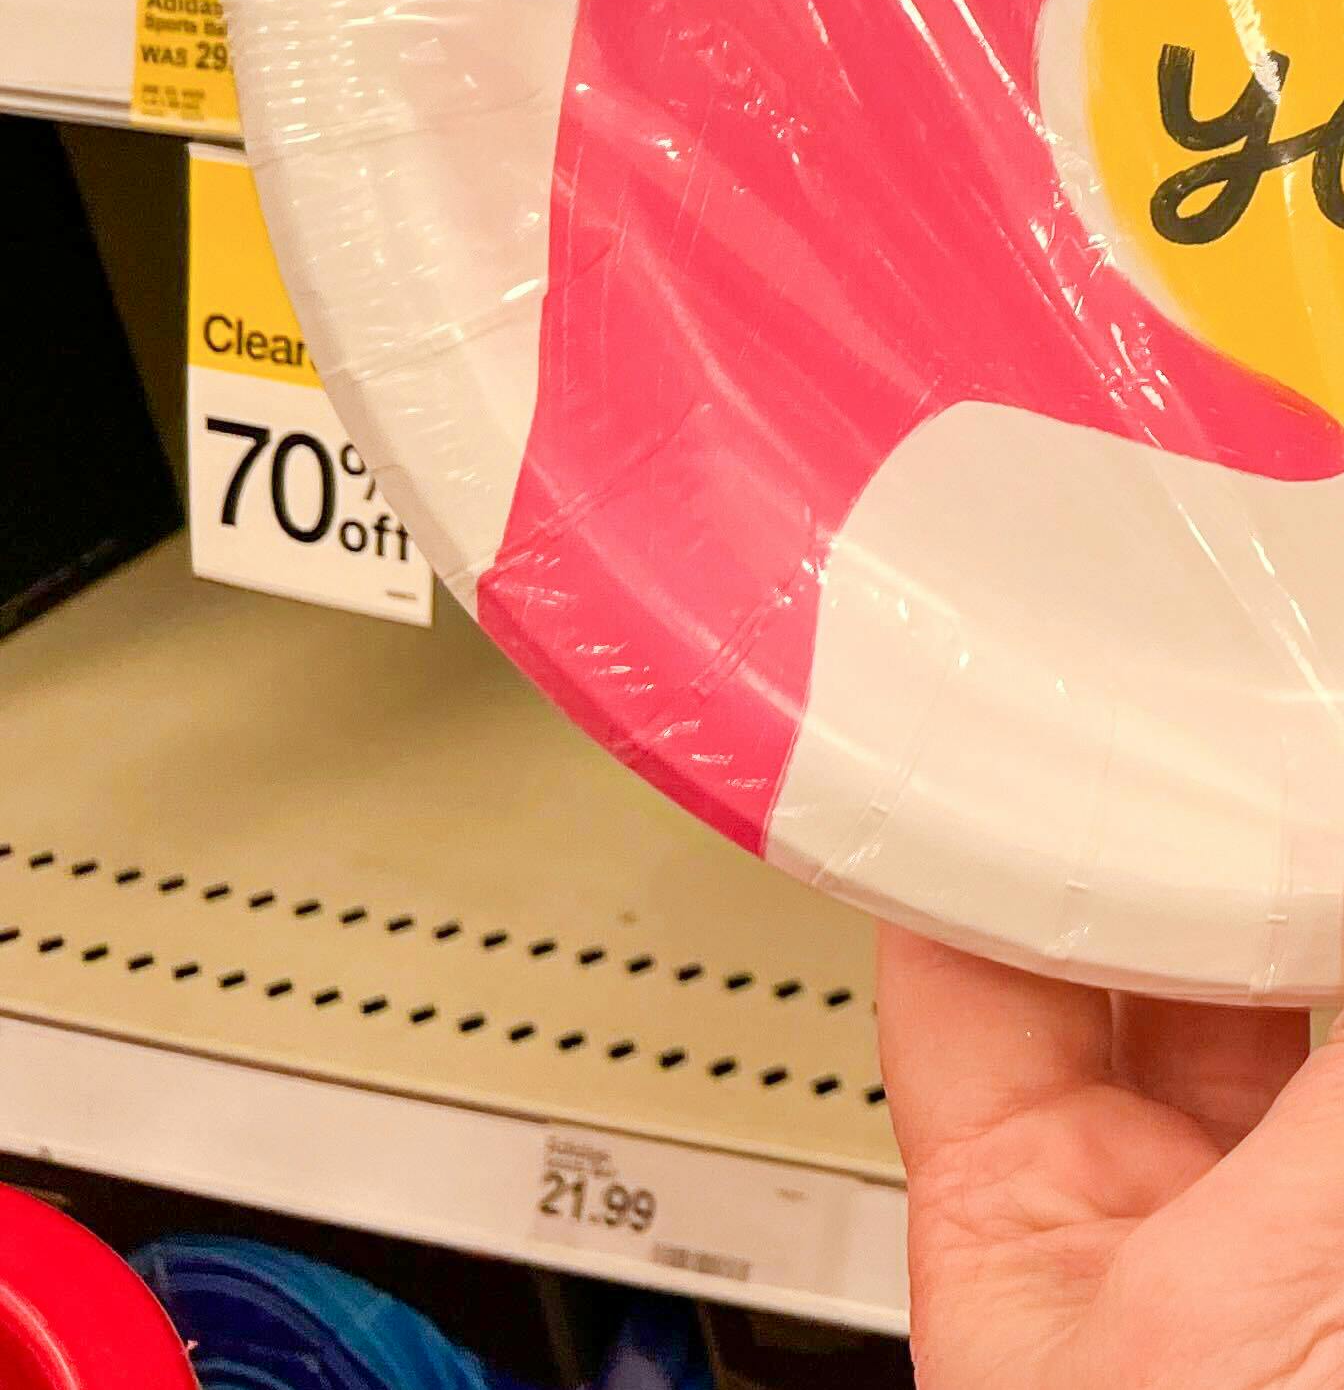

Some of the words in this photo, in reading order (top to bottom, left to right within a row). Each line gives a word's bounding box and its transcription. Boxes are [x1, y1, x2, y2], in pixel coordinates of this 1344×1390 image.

[141, 44, 188, 67] WAS
[203, 313, 317, 372] Clear
[540, 1171, 655, 1231] 21.99
